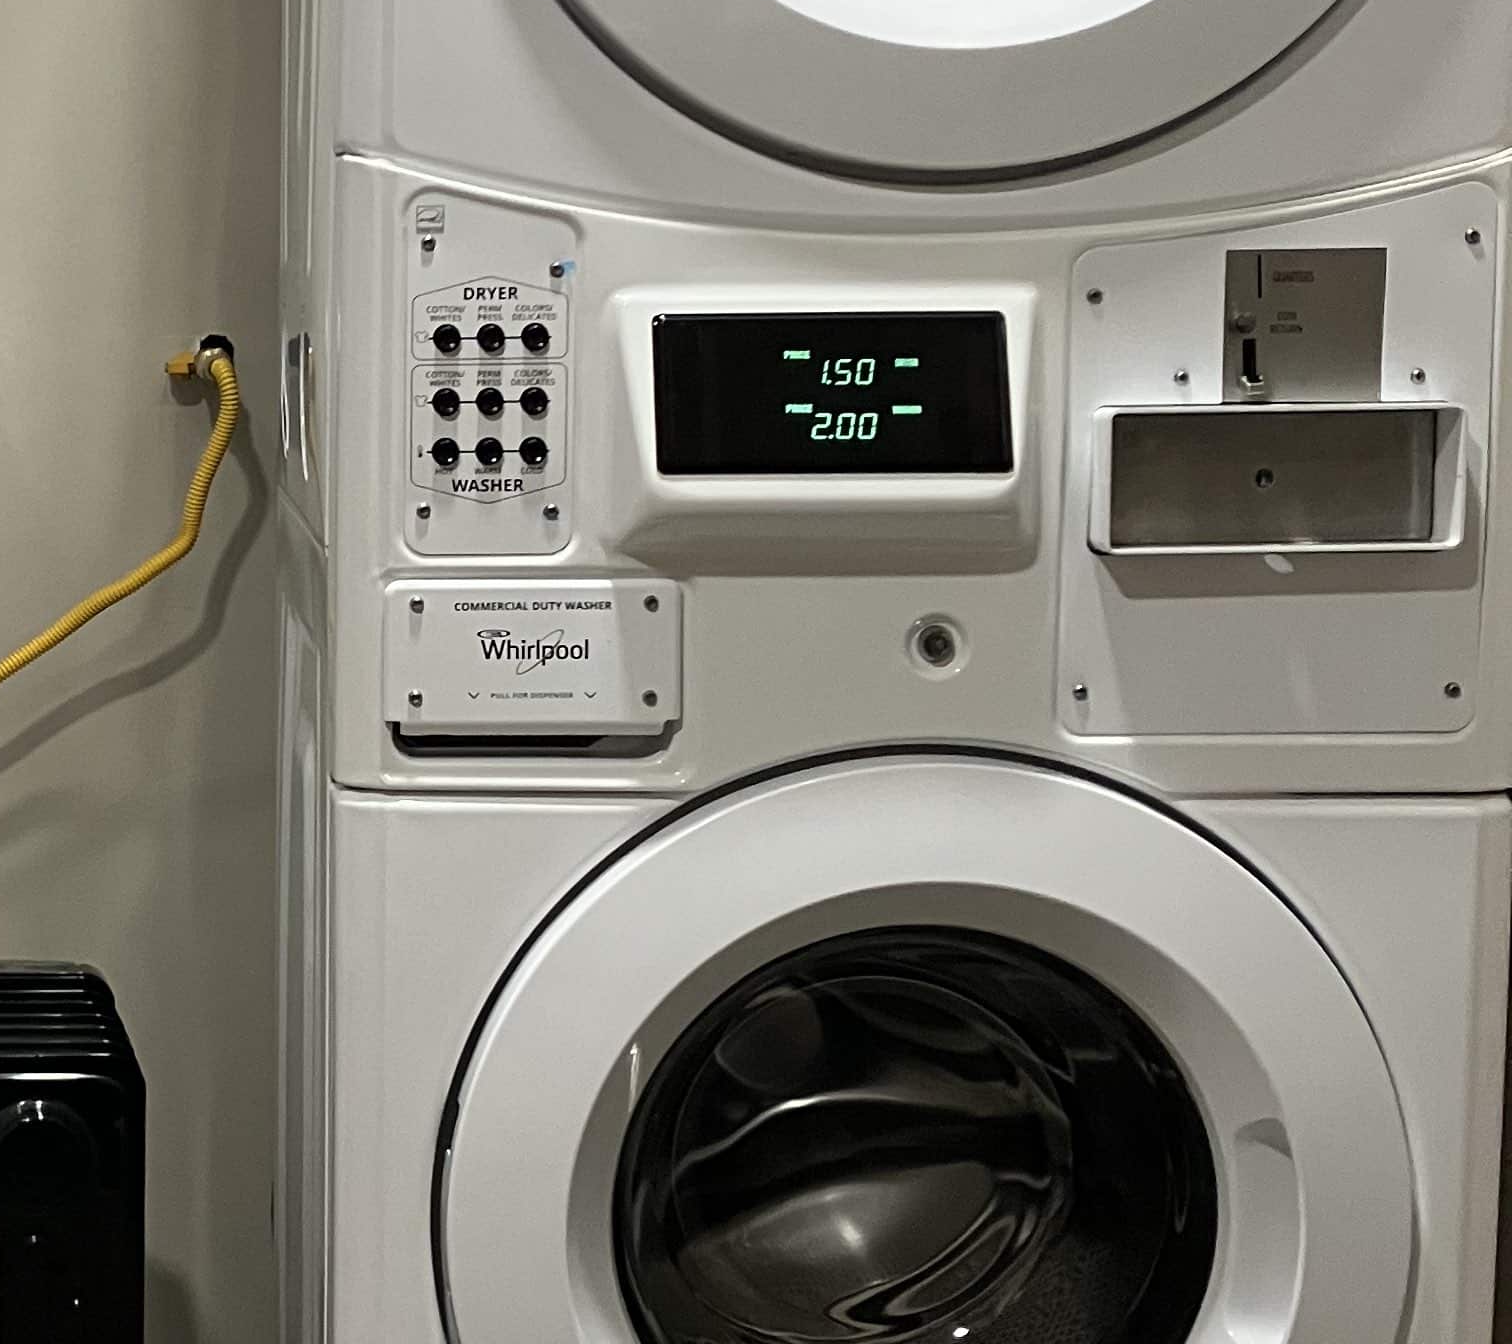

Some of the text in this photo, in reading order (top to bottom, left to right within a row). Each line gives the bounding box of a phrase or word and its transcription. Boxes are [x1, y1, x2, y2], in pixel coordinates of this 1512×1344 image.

[463, 286, 518, 301] DRYER
[821, 358, 876, 386] 1.50
[810, 412, 879, 440] 2.00
[452, 478, 524, 492] WASHER
[454, 601, 612, 611] COMMERCIAL DUTY WASHER
[481, 638, 589, 666] Whirlpool
